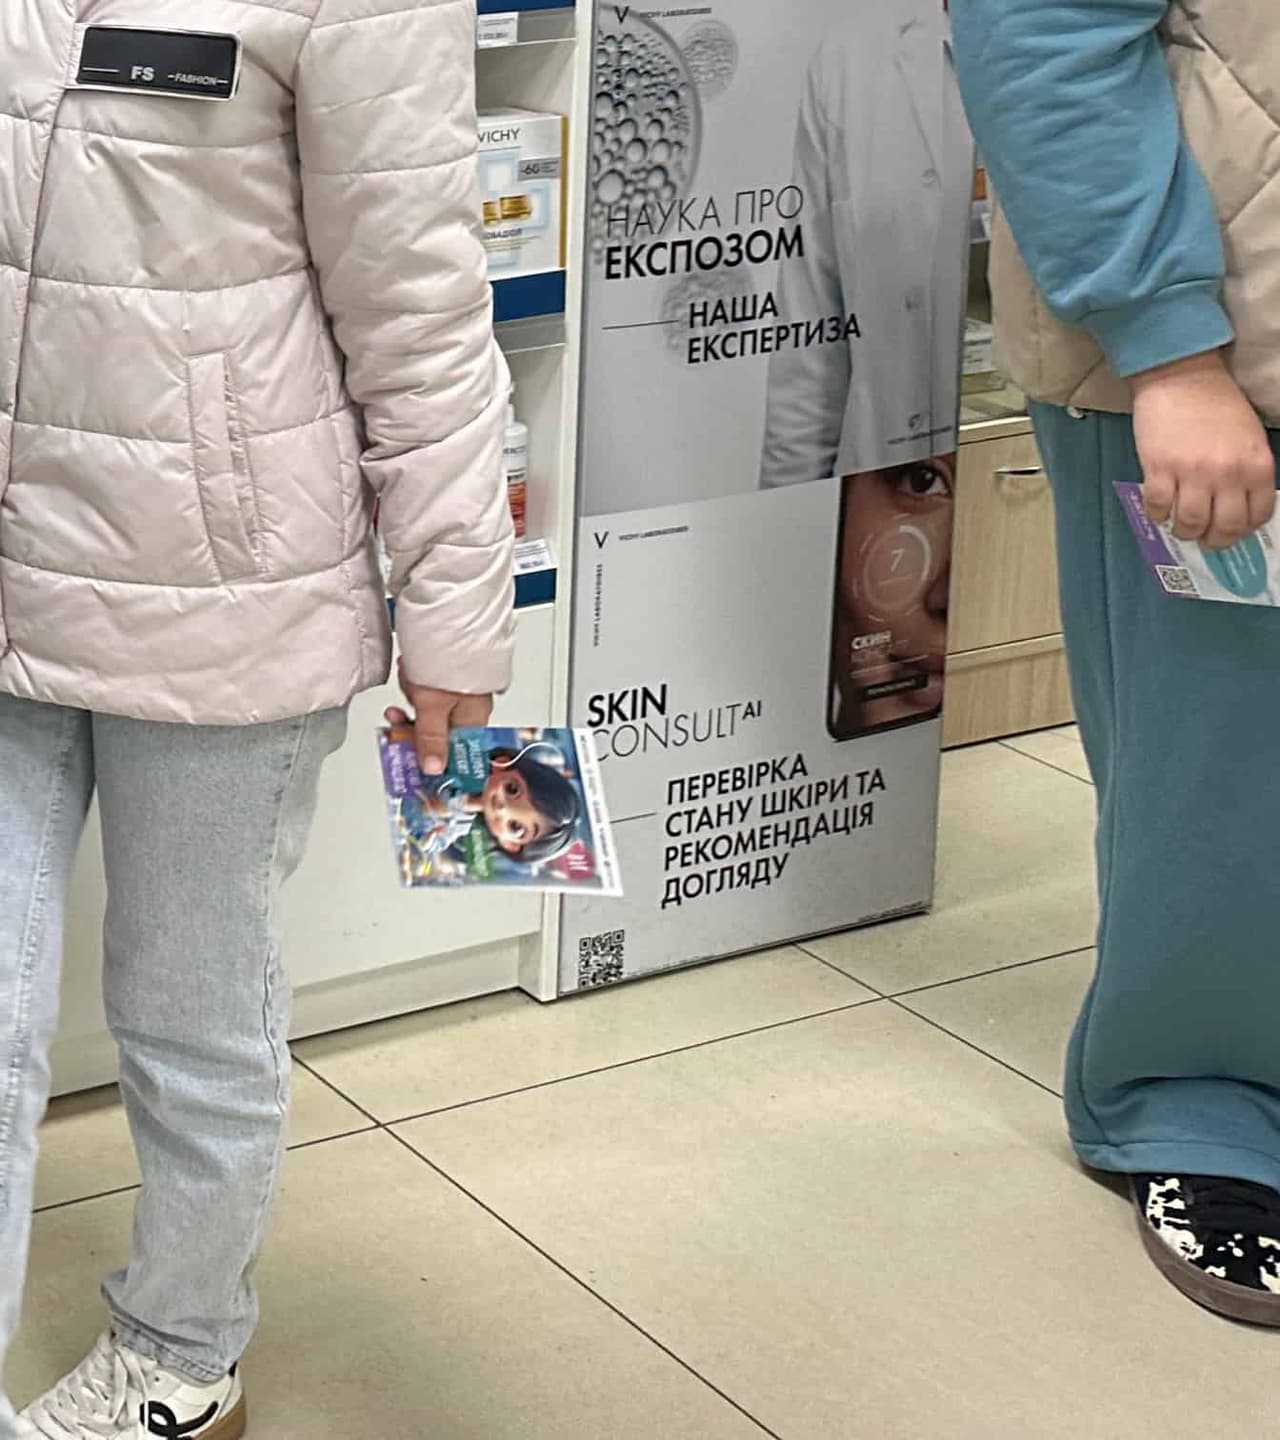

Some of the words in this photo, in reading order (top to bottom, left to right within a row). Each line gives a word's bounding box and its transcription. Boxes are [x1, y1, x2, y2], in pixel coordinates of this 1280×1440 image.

[131, 66, 154, 81] FS
[607, 197, 721, 239] НАУКА
[735, 185, 804, 226] ПРО
[604, 226, 805, 280] ЕКСПОЗОМ
[689, 292, 778, 328] НАША
[687, 315, 861, 364] ЕКСПЕРТИЗА
[891, 550, 903, 573] 7
[586, 684, 667, 728] SKIN
[665, 797, 753, 838] СТАНУ
[761, 778, 847, 818] ШКІРИ
[856, 768, 886, 794] ТА
[667, 753, 808, 805] ПЕРЕВІРКА
[664, 803, 874, 870] РЕКОМЕНДАЦІЯ
[661, 853, 790, 909] ДОГЛЯДУ
